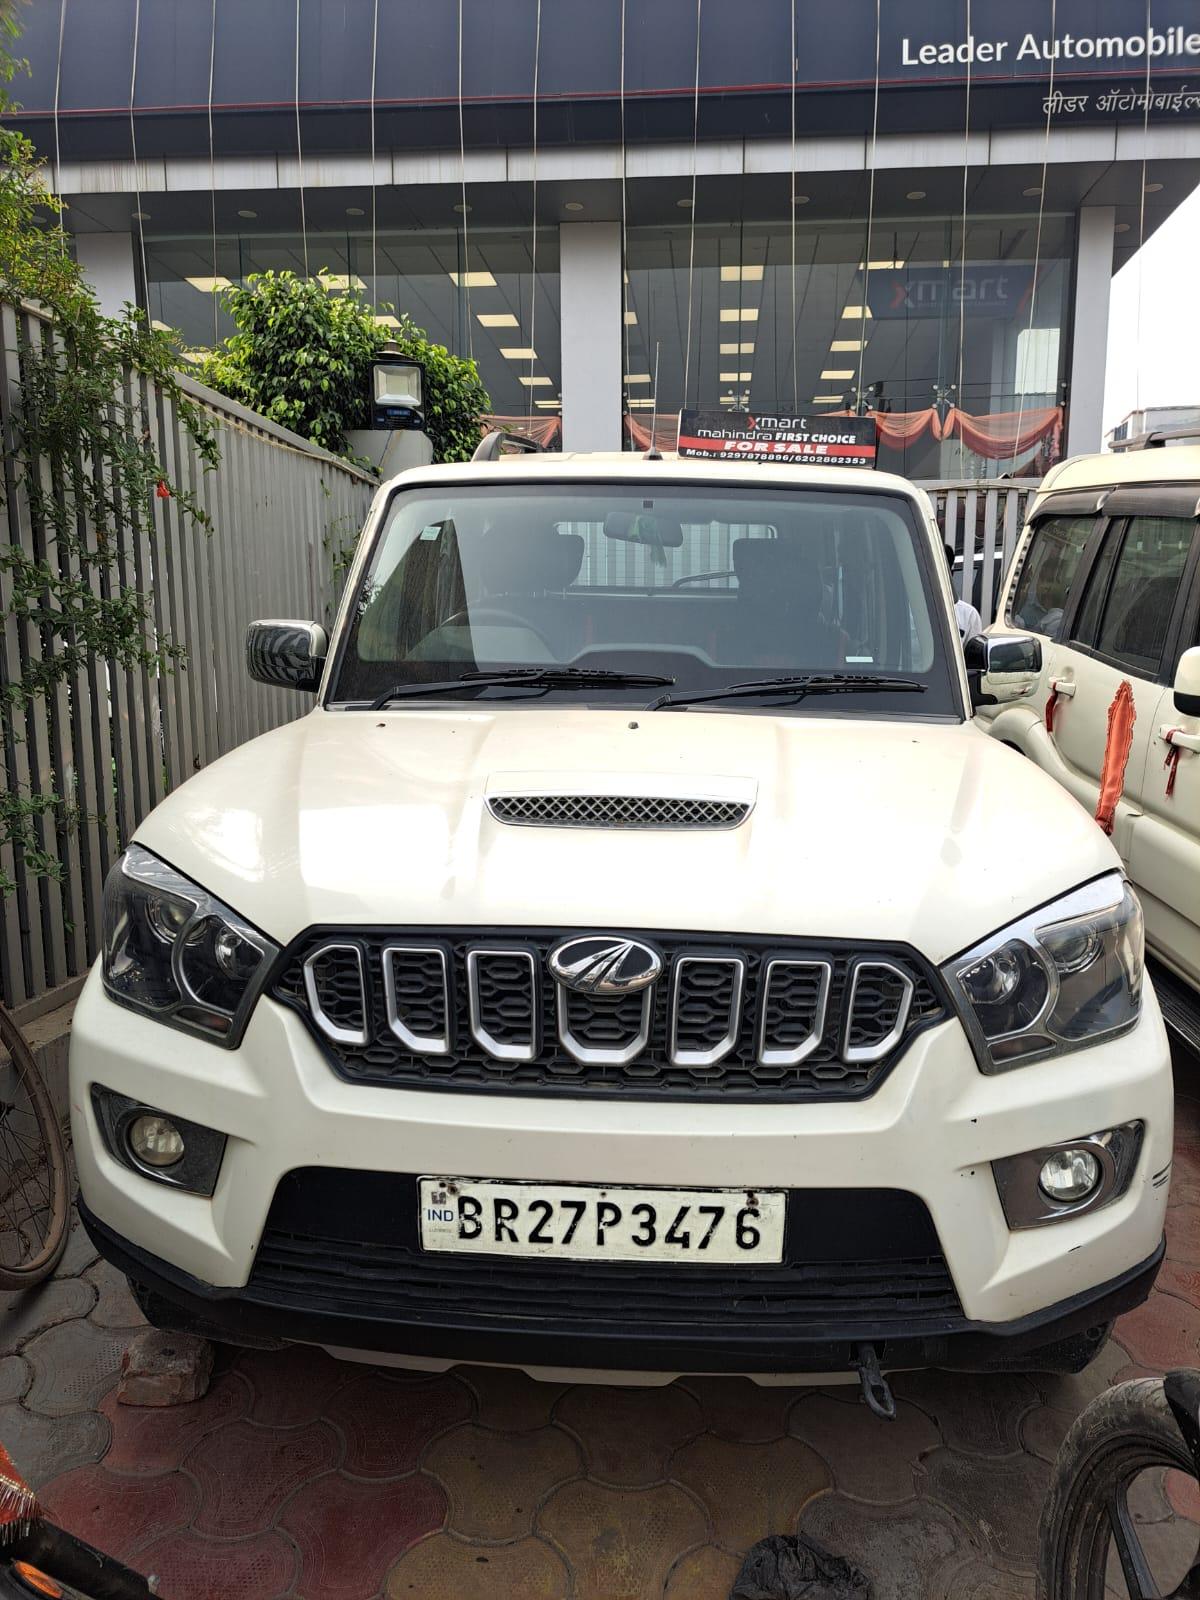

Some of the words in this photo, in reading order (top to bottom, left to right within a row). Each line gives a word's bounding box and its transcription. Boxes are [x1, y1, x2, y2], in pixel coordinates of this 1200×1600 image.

[901, 36, 1008, 66] Leader
[1042, 90, 1089, 114] लीडर
[697, 429, 773, 441] mahindra
[775, 432, 809, 442] FIRST
[811, 433, 856, 444] CHOICE
[723, 441, 769, 451] FOR
[774, 443, 828, 454] SALE
[427, 1208, 454, 1222] IND
[458, 1195, 760, 1249] BR27P3476
